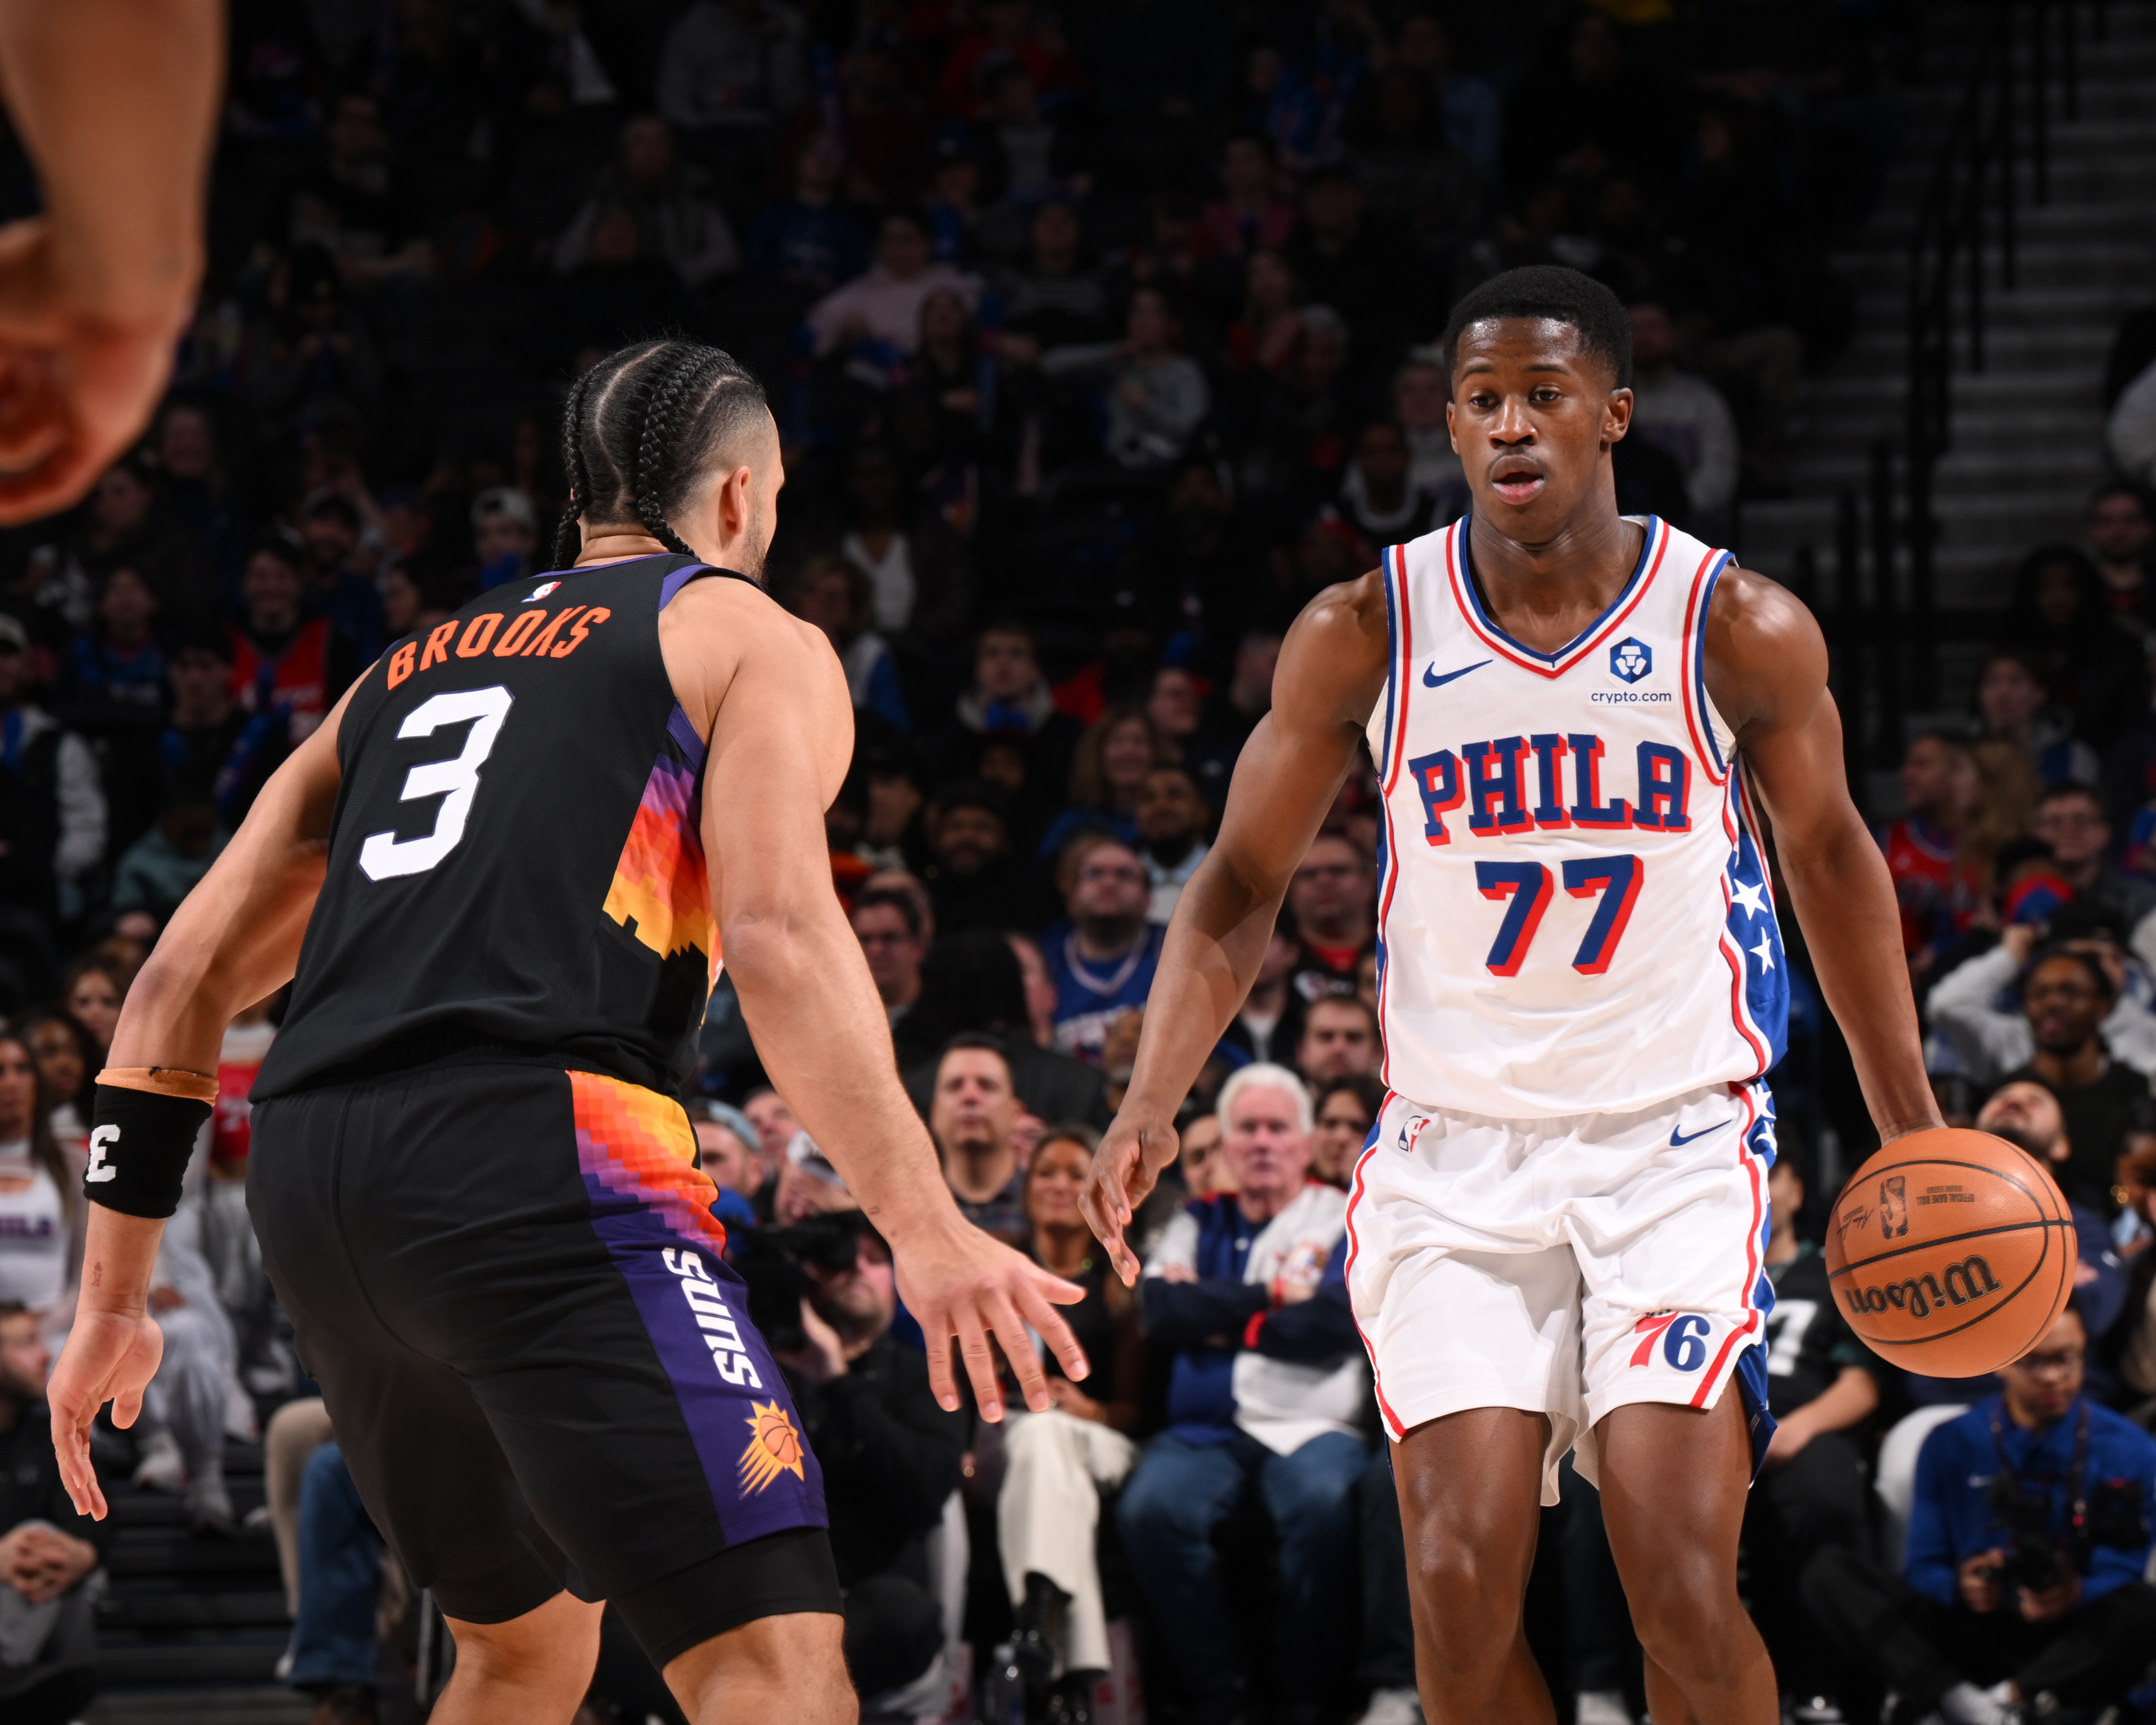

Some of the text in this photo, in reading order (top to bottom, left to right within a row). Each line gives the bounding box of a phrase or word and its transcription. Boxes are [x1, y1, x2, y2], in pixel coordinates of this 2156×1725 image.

[388, 605, 611, 691] BROOKS
[1591, 691, 1672, 704] crypto.com
[357, 683, 515, 884] 3
[1408, 733, 1691, 846] PHILA
[1474, 854, 1644, 977] 77
[662, 1247, 763, 1389] SUNS
[1844, 1255, 2003, 1319] Wilson
[1629, 1310, 1711, 1371] 76
